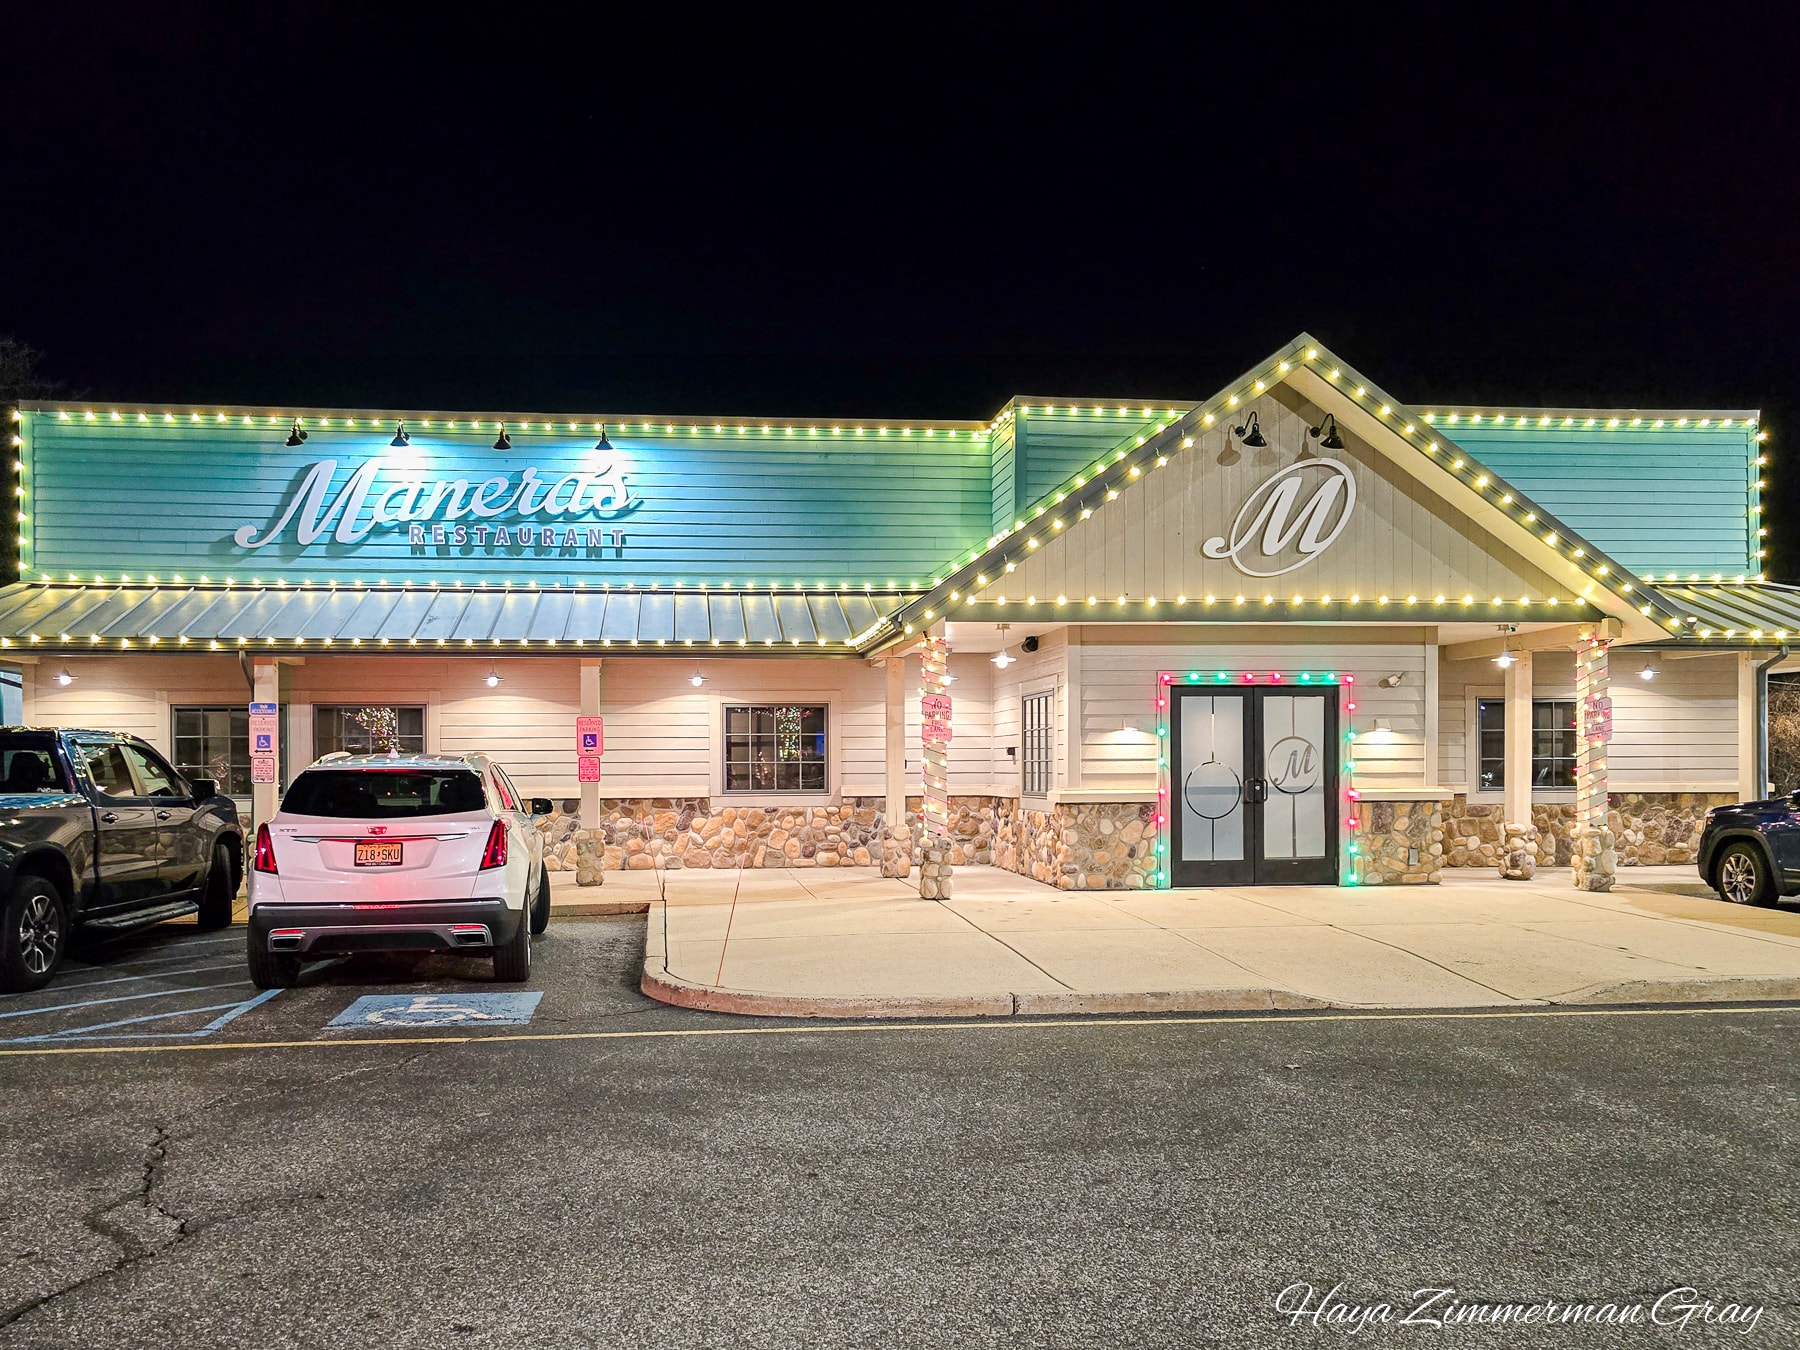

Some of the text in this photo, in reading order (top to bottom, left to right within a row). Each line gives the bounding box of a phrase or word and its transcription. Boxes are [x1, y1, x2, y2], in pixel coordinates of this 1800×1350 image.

[234, 458, 639, 549] Manera's
[408, 525, 625, 547] RESTAURANT
[931, 701, 942, 709] NO
[1593, 702, 1603, 710] NO
